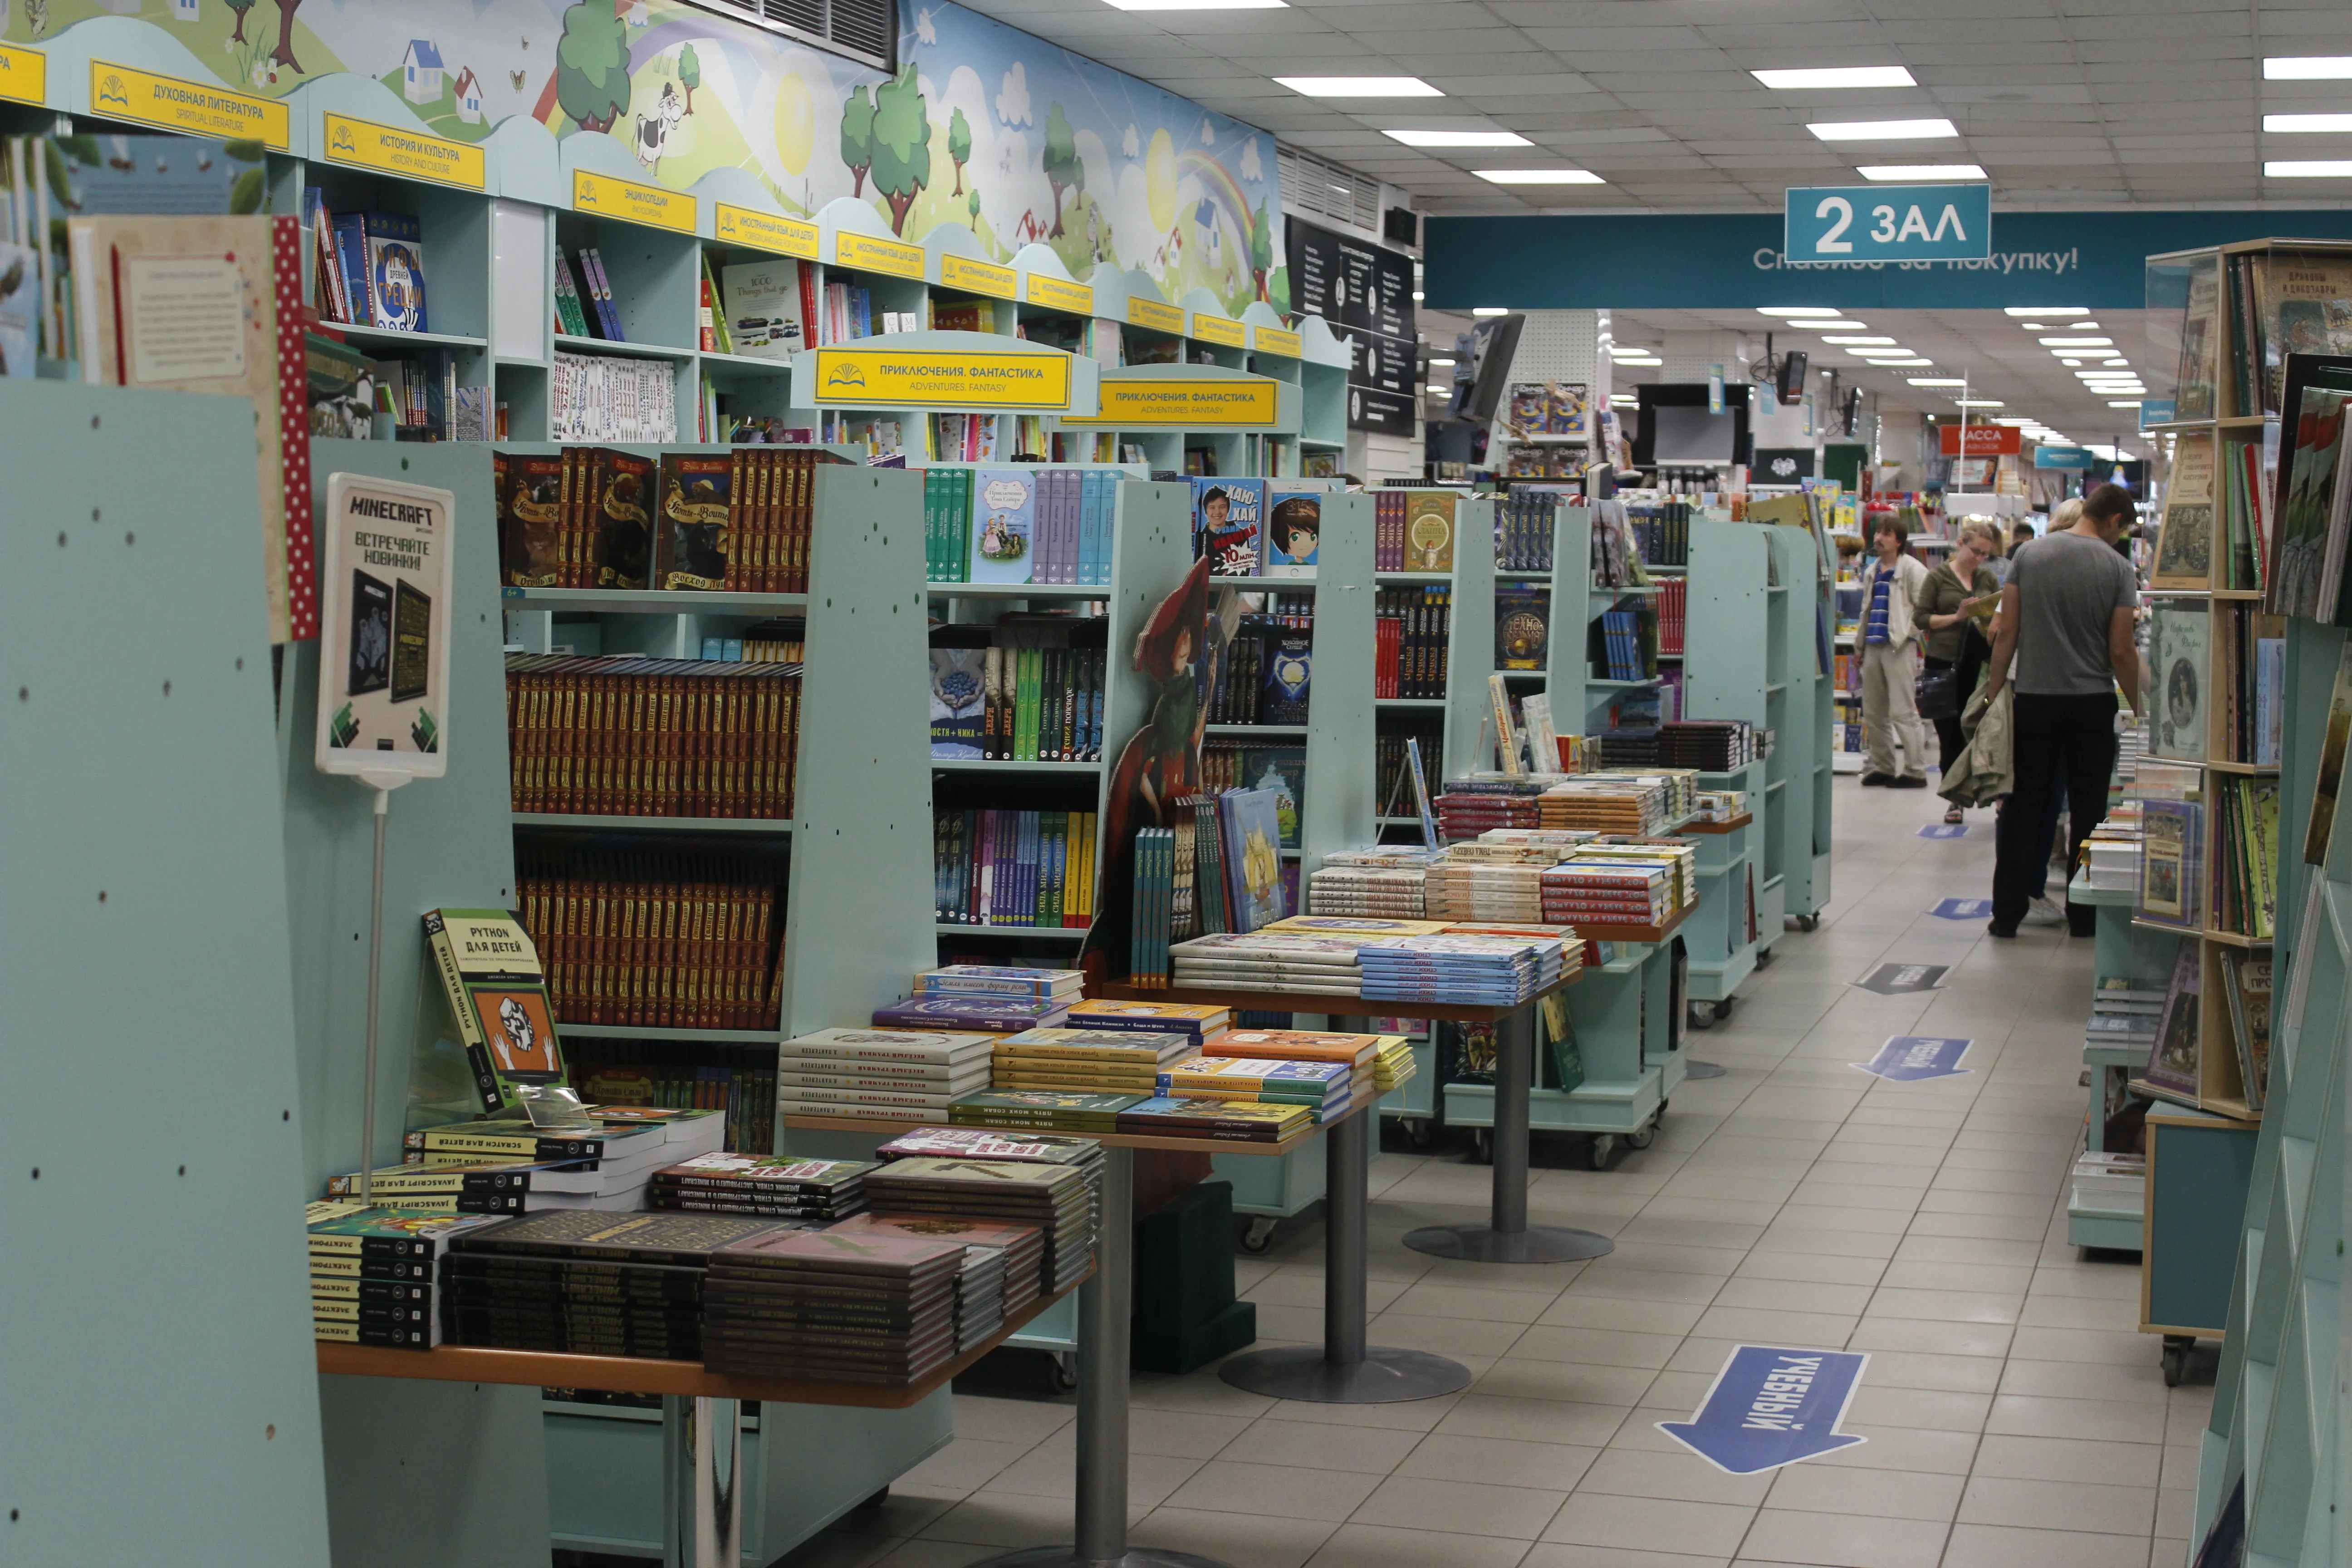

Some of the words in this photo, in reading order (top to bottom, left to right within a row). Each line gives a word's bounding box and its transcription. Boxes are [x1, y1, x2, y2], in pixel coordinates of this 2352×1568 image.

[154, 83, 206, 107] ДУХОВНАЯ
[207, 97, 264, 121] ЛИТЕРАТУРА
[176, 108, 207, 124] SPIRITUAL
[209, 114, 245, 132] LITERATURE
[380, 134, 416, 151] ИСТОРИЯ
[417, 142, 422, 153] И
[425, 144, 460, 162] КУЛЬТУРА
[391, 153, 413, 165] HISTORY
[414, 158, 426, 169] AND
[427, 162, 450, 174] CULTURE
[625, 189, 668, 207] ЭНЦИКЛОПЕДИИ
[740, 216, 775, 231] ИНОСТРАННЫЙ
[776, 224, 789, 235] ЯЗЫК
[789, 228, 800, 238] ДЛЯ
[800, 229, 814, 241] ДЕТЕЙ
[1815, 196, 1853, 253] 2
[1871, 204, 1967, 242] ЗАЛ
[375, 245, 420, 271] МИФЫ
[390, 270, 410, 280] ДРЕВНЕЙ
[751, 277, 771, 287] 1000
[378, 282, 422, 308] ГРЕЦИИ
[880, 365, 966, 377] ПРИКЛЮЧЕНИЯ.
[970, 367, 1043, 379] ФАНТАСТИКА
[910, 382, 966, 391] ADVENTURES.
[969, 383, 1006, 392] FANTASY
[1116, 392, 1189, 402] ПРИКЛЮЧЕНИЯ.
[1192, 393, 1254, 402] ФАНТАСТИКА
[1225, 485, 1258, 505] ХАЮ-
[350, 496, 432, 526] MINECRAFT
[1233, 506, 1259, 524] ХАЙ,
[355, 531, 430, 555] ВСТРЕЧАЙТЕ
[365, 549, 421, 571] НОВИНКИ!
[1225, 546, 1238, 564] 10
[986, 707, 994, 735] ДВЕРИ
[1004, 707, 1012, 736] ДВЕРИ
[958, 728, 975, 738] НИКА
[1039, 833, 1049, 888] МИЛОСЕРДИЯ
[1054, 833, 1063, 888] МИЛОСЕРДИЯ
[470, 927, 510, 939] PYTHON
[466, 941, 489, 953] ДЛЯ
[492, 941, 522, 953] ДЕТЕЙ
[439, 946, 454, 973] ДЕТЕЙ
[448, 975, 461, 998] ДЛЯ
[987, 982, 1009, 991] форму
[457, 1000, 471, 1029] PYTHON
[438, 1139, 464, 1147] ДЕТЕЙ
[485, 1141, 521, 1149] SCRATCH
[371, 1180, 386, 1188] ДЕТ
[407, 1178, 455, 1187] JAVASCRIPT
[681, 1177, 709, 1186] MINECRAFT
[715, 1180, 754, 1189] ЗАСТРЯВШЕГО
[677, 1190, 706, 1198] MINECRAFT
[775, 1184, 800, 1192] ДНЕВНИК
[713, 1192, 751, 1201] ЗАСТРЯВШЕГО
[773, 1196, 798, 1204] ДНЕВНИК
[400, 1200, 449, 1209] JAVASCRIPT
[681, 1201, 710, 1210] MINECRAFT
[717, 1203, 755, 1213] ЗАСТРЯВШЕГО
[777, 1207, 802, 1215] ДНЕВНИК
[307, 1239, 353, 1248] ЭЛЕКТРОНИ
[309, 1261, 353, 1269] ЭЛЕКТРОН
[314, 1327, 350, 1335] ЭЛЕКТРО
[1741, 1356, 1823, 1431] УЧЕБНЫЙ
